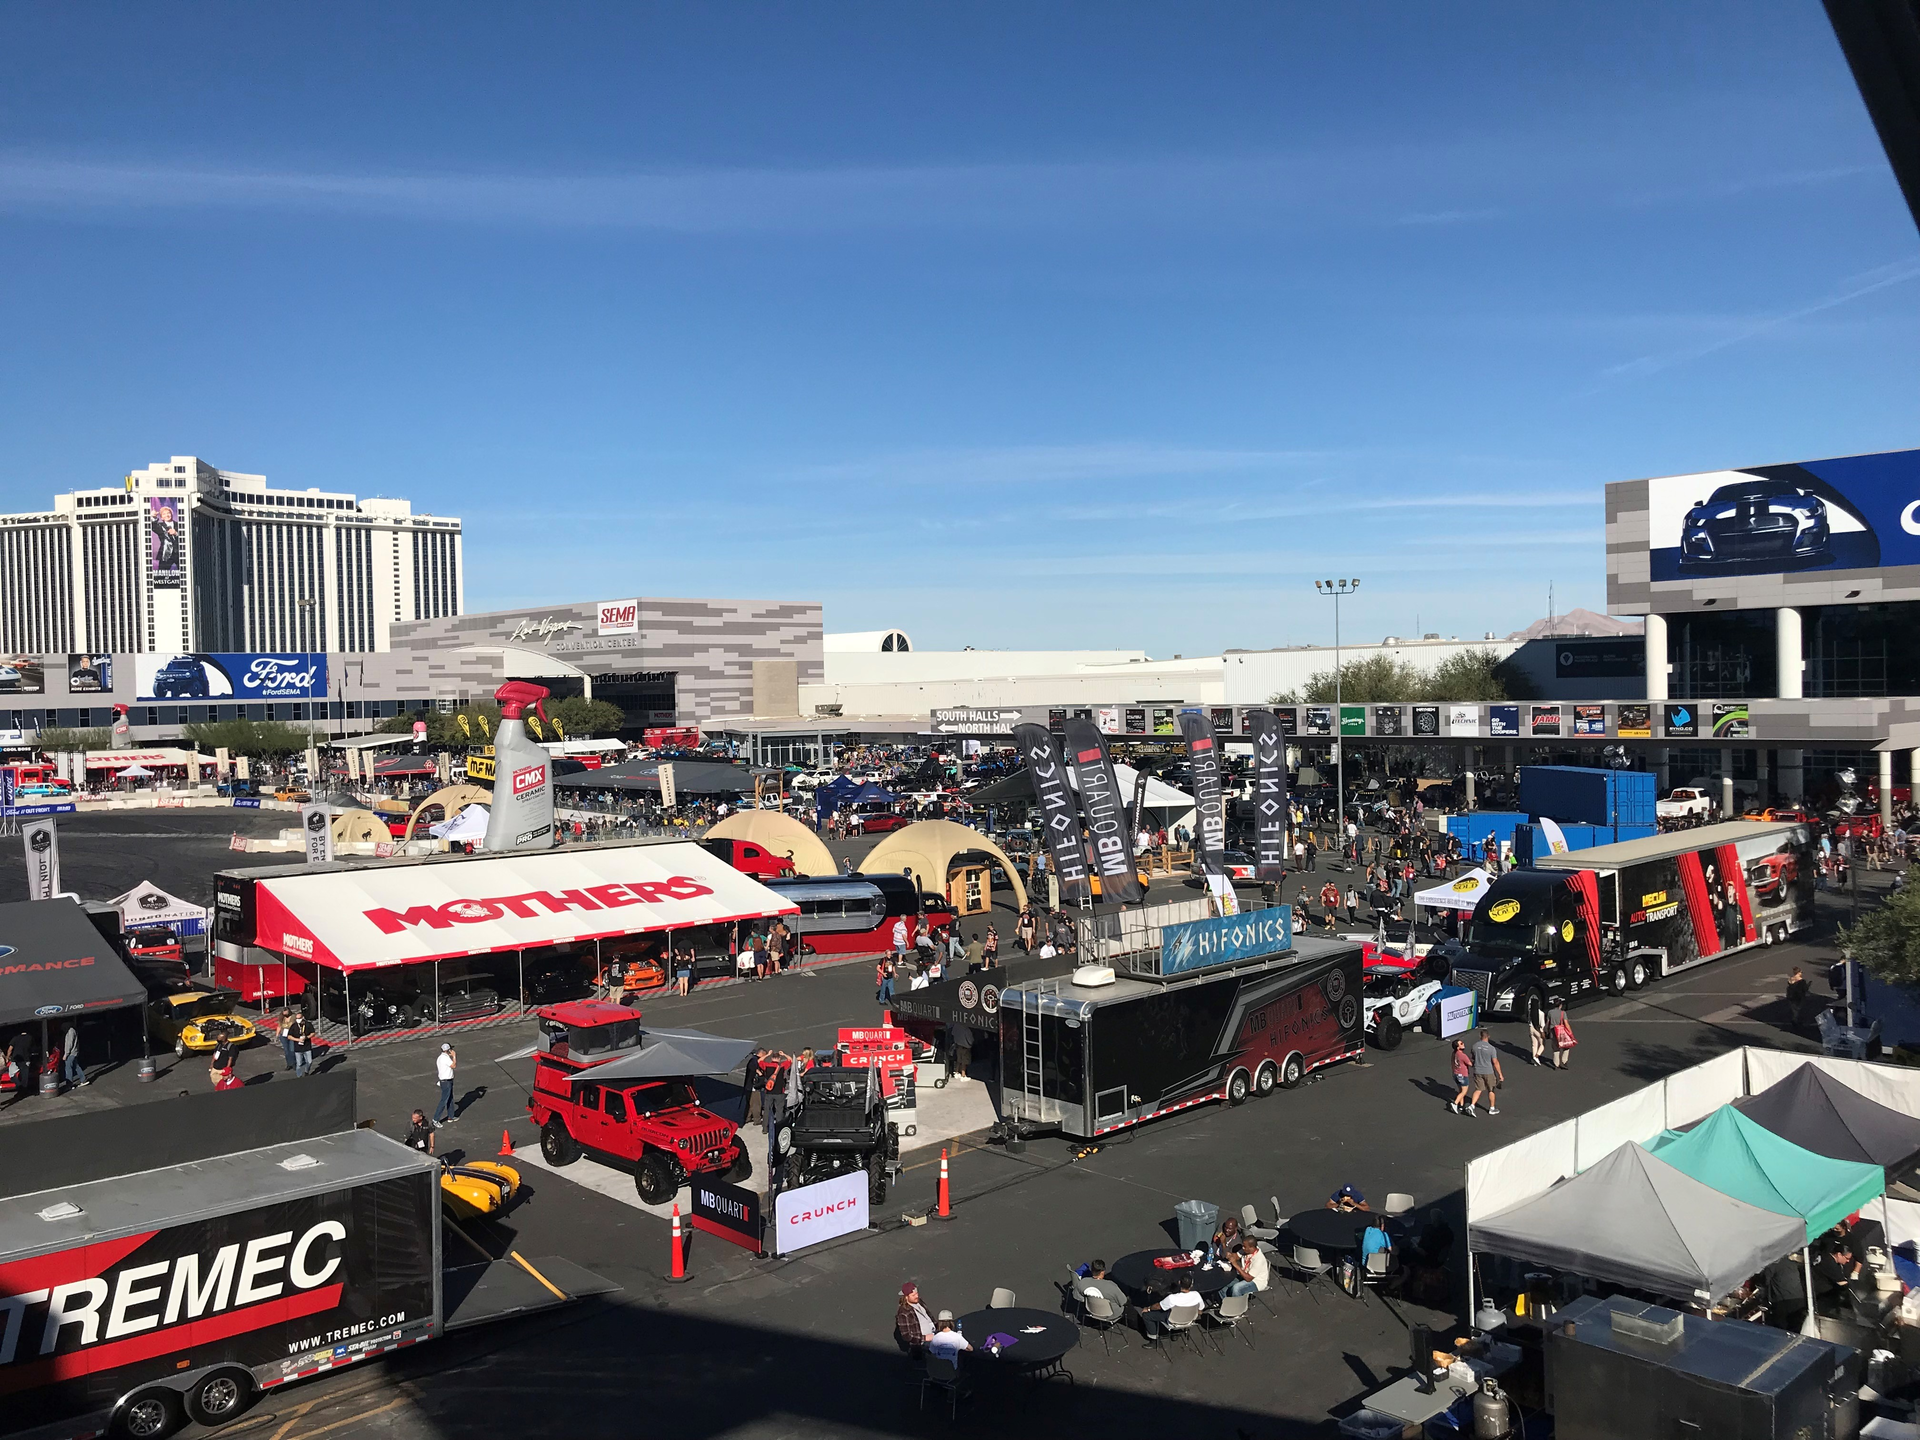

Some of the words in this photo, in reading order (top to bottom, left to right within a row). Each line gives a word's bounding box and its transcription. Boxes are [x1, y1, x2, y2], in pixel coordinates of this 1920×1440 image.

[153, 569, 180, 577] MANILOW
[601, 605, 636, 624] SEMA
[510, 620, 534, 642] Las
[536, 616, 583, 646] Vegas
[556, 640, 603, 651] CONVENTION
[608, 637, 637, 648] CENTER
[243, 658, 317, 688] Ford
[937, 711, 968, 721] SOUTH
[970, 711, 999, 721] HALLS
[1531, 715, 1561, 727] JAMO
[958, 724, 988, 734] NORTH
[86, 754, 166, 763] OTHERS
[516, 768, 543, 789] CMX
[516, 786, 545, 801] CERAMIC
[516, 832, 533, 846] PRO
[40, 858, 48, 882] JOIN
[217, 892, 241, 907] MOTHERS
[362, 875, 714, 935] MOTHERS
[1630, 910, 1646, 923] AUTO
[1646, 906, 1678, 923] TRANSPORT
[283, 932, 314, 953] MOTHERS
[1199, 917, 1285, 956] HIFONICS
[900, 1000, 936, 1018] MBQUART
[952, 1010, 999, 1029] HIFONIC
[1270, 1006, 1329, 1047] HIFONICS
[852, 1031, 886, 1040] MBQUART
[850, 1054, 905, 1064] CRUNCH
[700, 1188, 744, 1221] MBQUART
[790, 1197, 857, 1225] CRUNCH
[0, 1219, 346, 1364] TREMEC
[288, 1311, 405, 1354] WWW.TREMEC.COM
